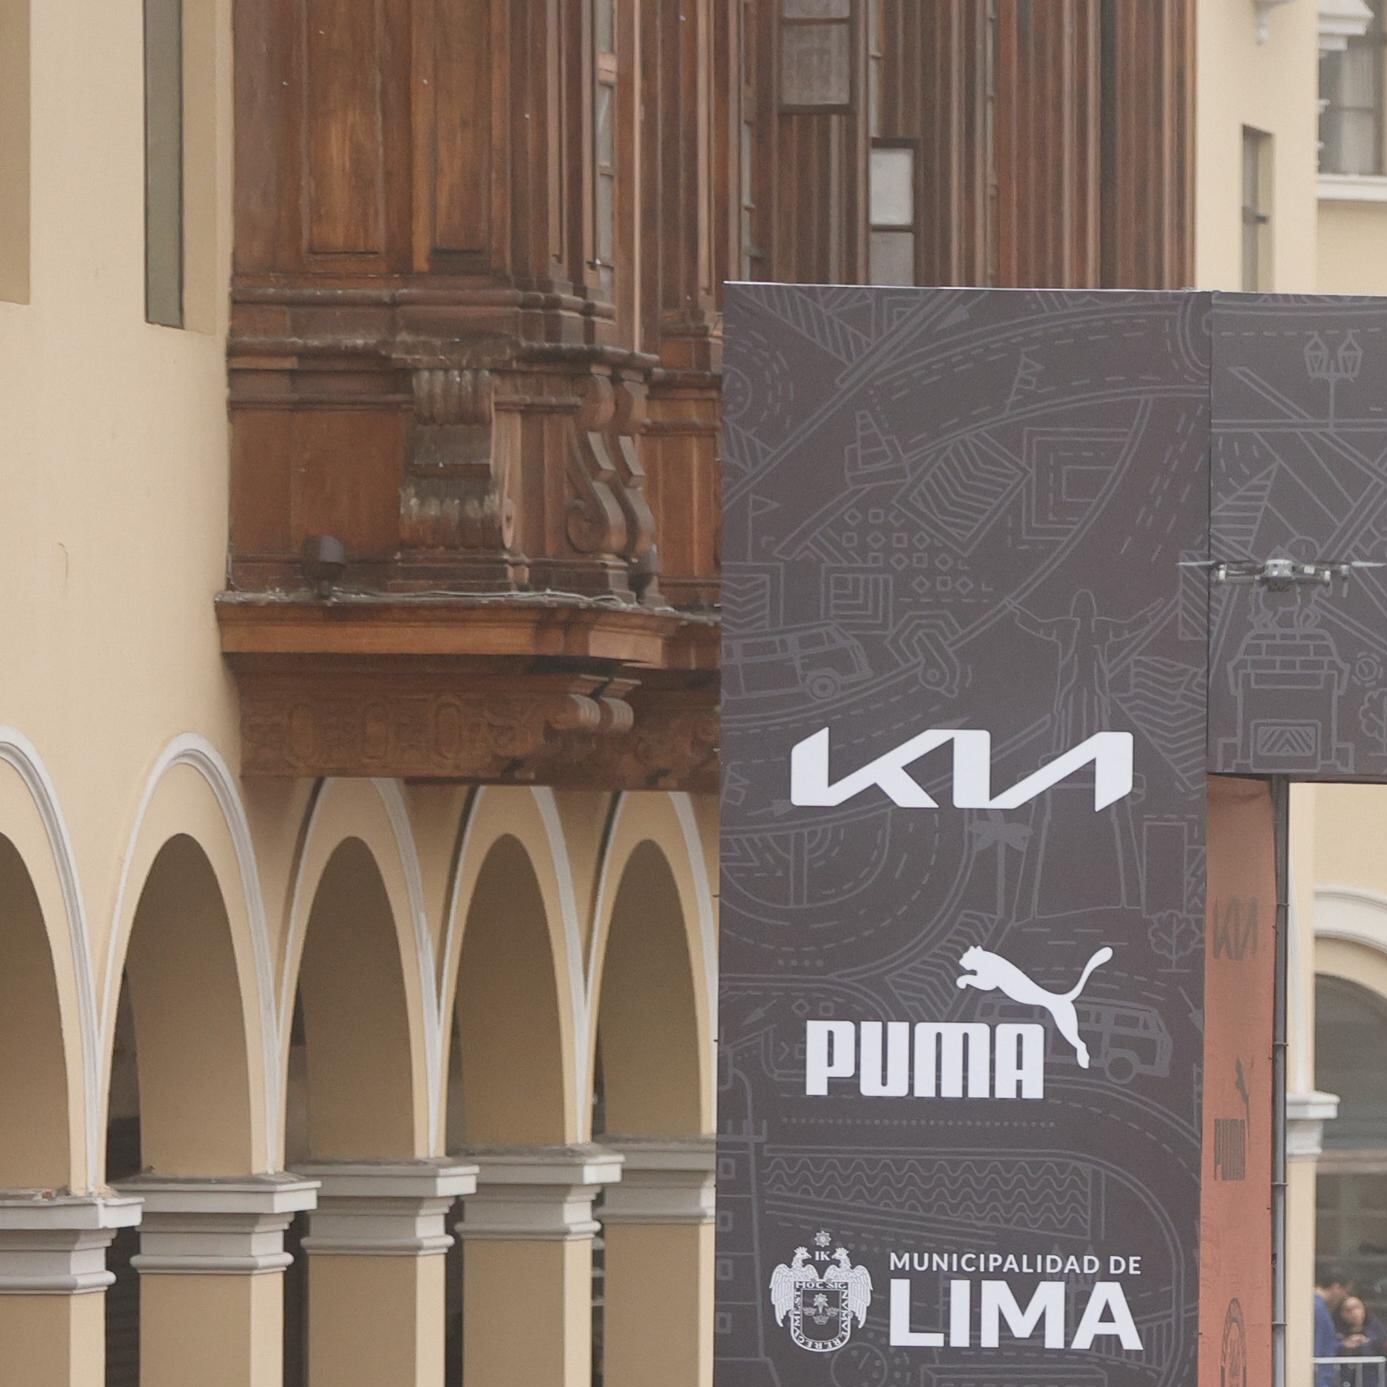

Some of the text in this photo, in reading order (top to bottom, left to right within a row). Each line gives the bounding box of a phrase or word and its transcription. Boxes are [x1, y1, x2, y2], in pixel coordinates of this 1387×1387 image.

[791, 727, 1133, 812] KIA
[806, 1020, 1045, 1100] PUMA
[814, 1251, 831, 1261] IK
[890, 1252, 1143, 1275] MUNICIPALIDAD DE
[890, 1278, 1144, 1351] LIMA
